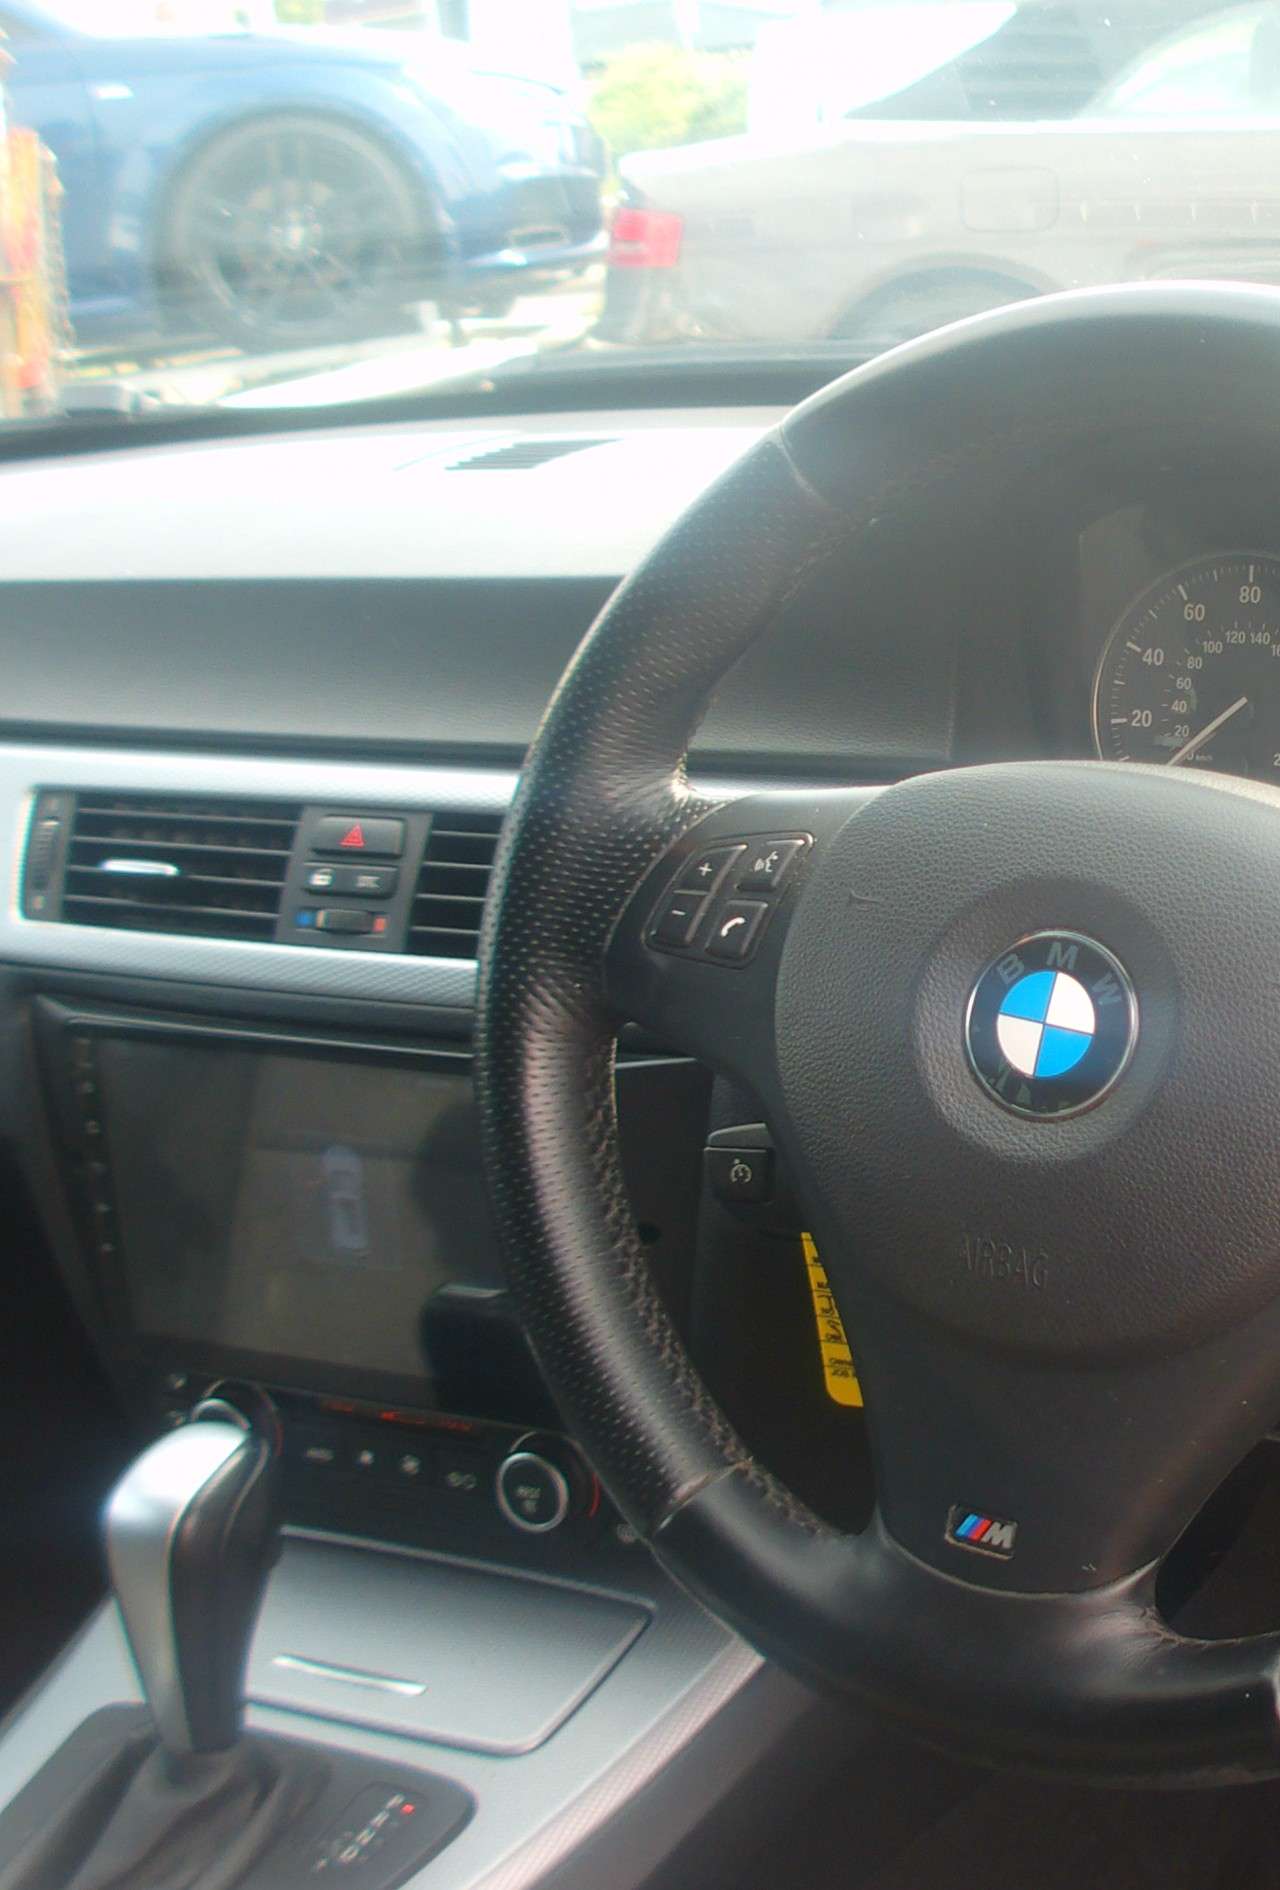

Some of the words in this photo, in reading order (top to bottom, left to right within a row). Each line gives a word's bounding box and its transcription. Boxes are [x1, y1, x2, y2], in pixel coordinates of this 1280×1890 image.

[1239, 586, 1261, 603] 80
[1184, 604, 1206, 621] 60
[1225, 631, 1246, 644] 120
[1250, 632, 1271, 645] 140
[1203, 641, 1223, 654] 100
[1142, 648, 1165, 666] 40
[1187, 656, 1203, 670] 80
[1176, 677, 1192, 691] 60
[1171, 700, 1188, 713] 40
[1131, 710, 1153, 728] 20
[1174, 724, 1190, 738] 20
